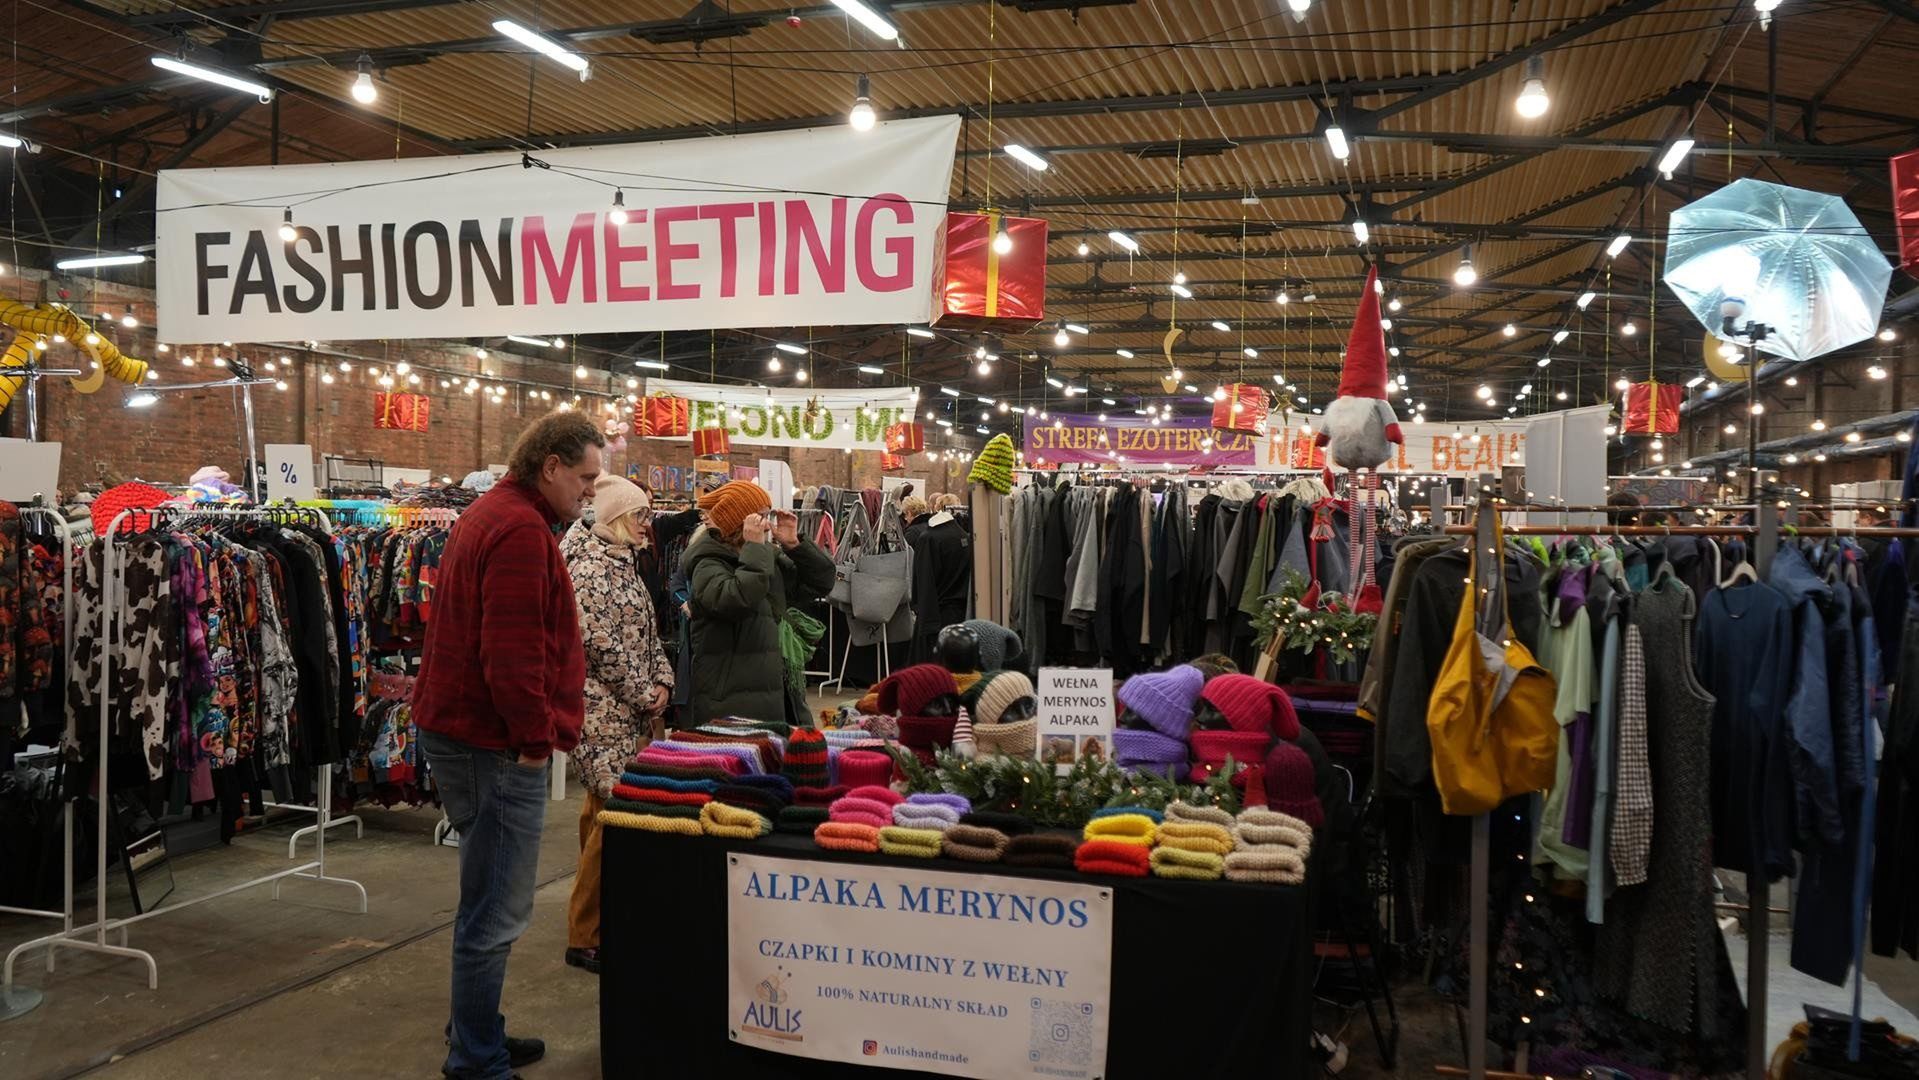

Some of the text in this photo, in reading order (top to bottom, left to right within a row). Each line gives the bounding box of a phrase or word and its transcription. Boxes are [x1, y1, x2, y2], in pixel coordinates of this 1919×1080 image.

[688, 401, 833, 440] ELONO
[1032, 427, 1111, 449] STREFA
[1432, 433, 1527, 471] BEAU
[280, 462, 297, 484] %
[1053, 678, 1098, 689] WEŁNA
[1044, 696, 1107, 708] MERYNOS
[1050, 714, 1099, 726] ALPAKA
[743, 871, 1089, 928] ALPAKA MERYNOS
[759, 939, 1069, 988] CZAPKI I KOMINY Z WEŁNY
[816, 986, 1008, 1018] 100% NATURALNY SKŁAD
[743, 1001, 802, 1033] AULIS
[883, 1045, 969, 1064] Aulishandmade
